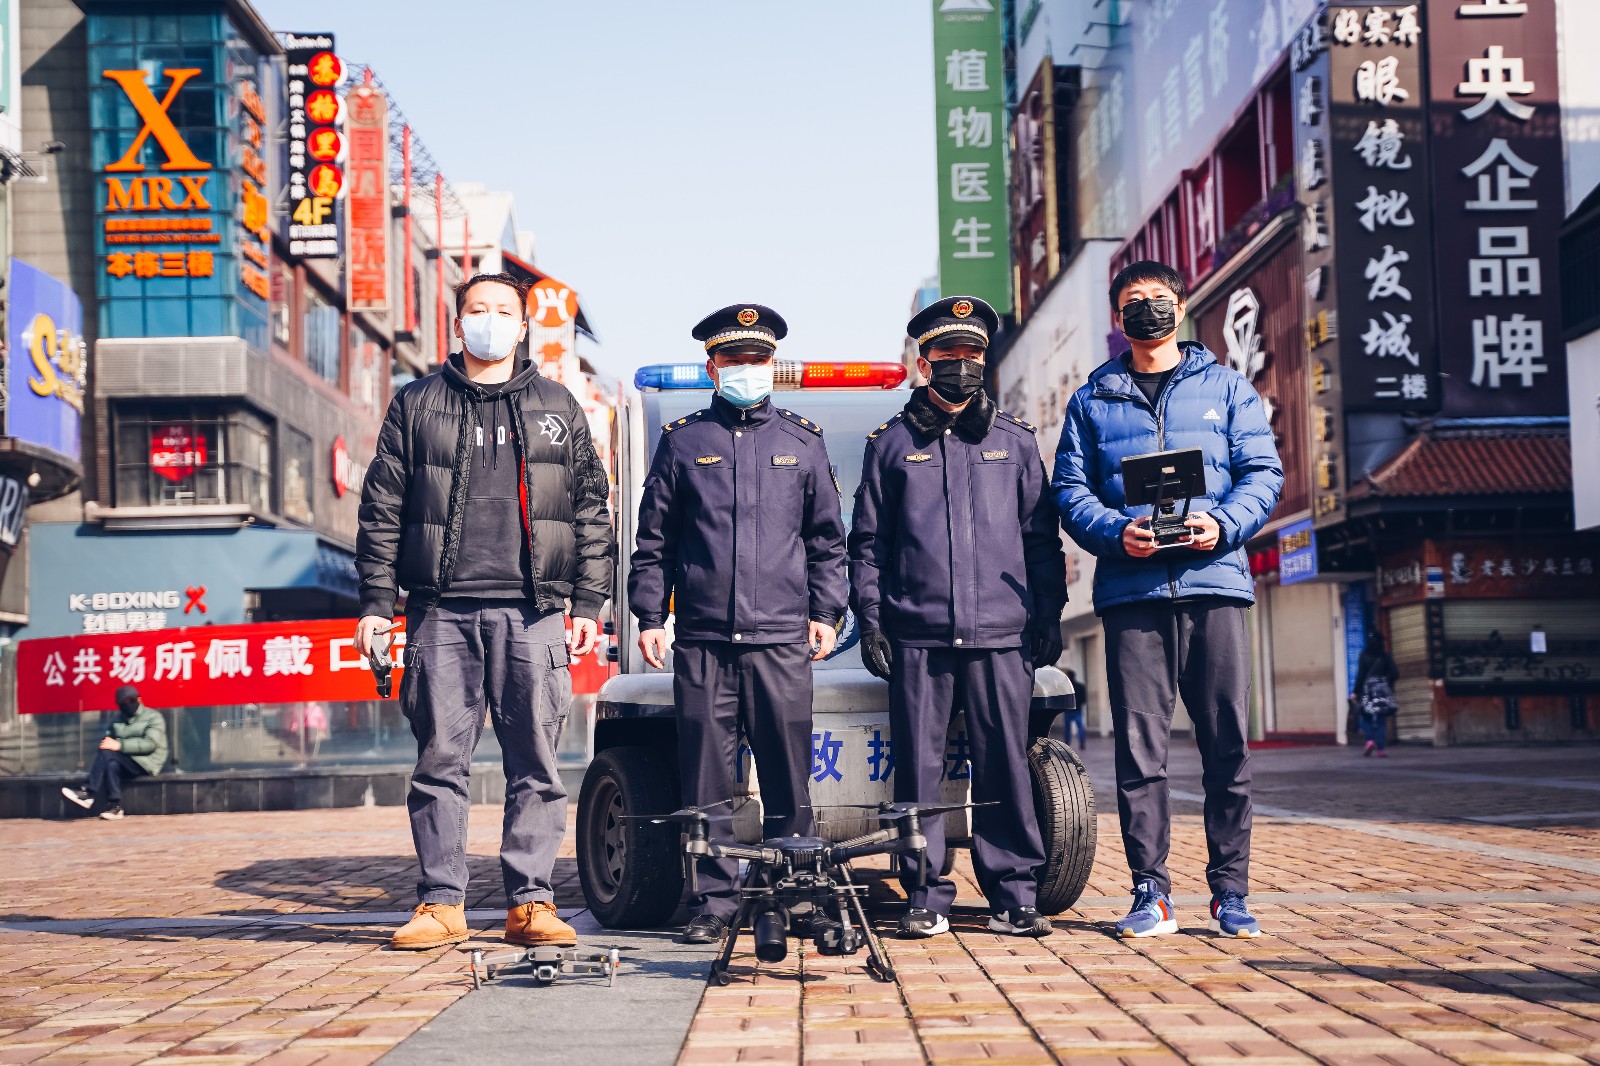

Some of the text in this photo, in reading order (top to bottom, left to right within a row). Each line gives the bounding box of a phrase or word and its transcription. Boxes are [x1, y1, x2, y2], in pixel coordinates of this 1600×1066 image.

[103, 69, 212, 172] X
[946, 50, 995, 259] 植物医生
[105, 176, 212, 211] MRX
[292, 198, 333, 226] 4F
[1353, 56, 1420, 366] 眼镜批发城
[1455, 0, 1548, 388] 央企品牌
[1374, 373, 1427, 399] 二楼
[69, 590, 180, 611] K-BOXING
[43, 632, 406, 687] 公共场所佩戴口
